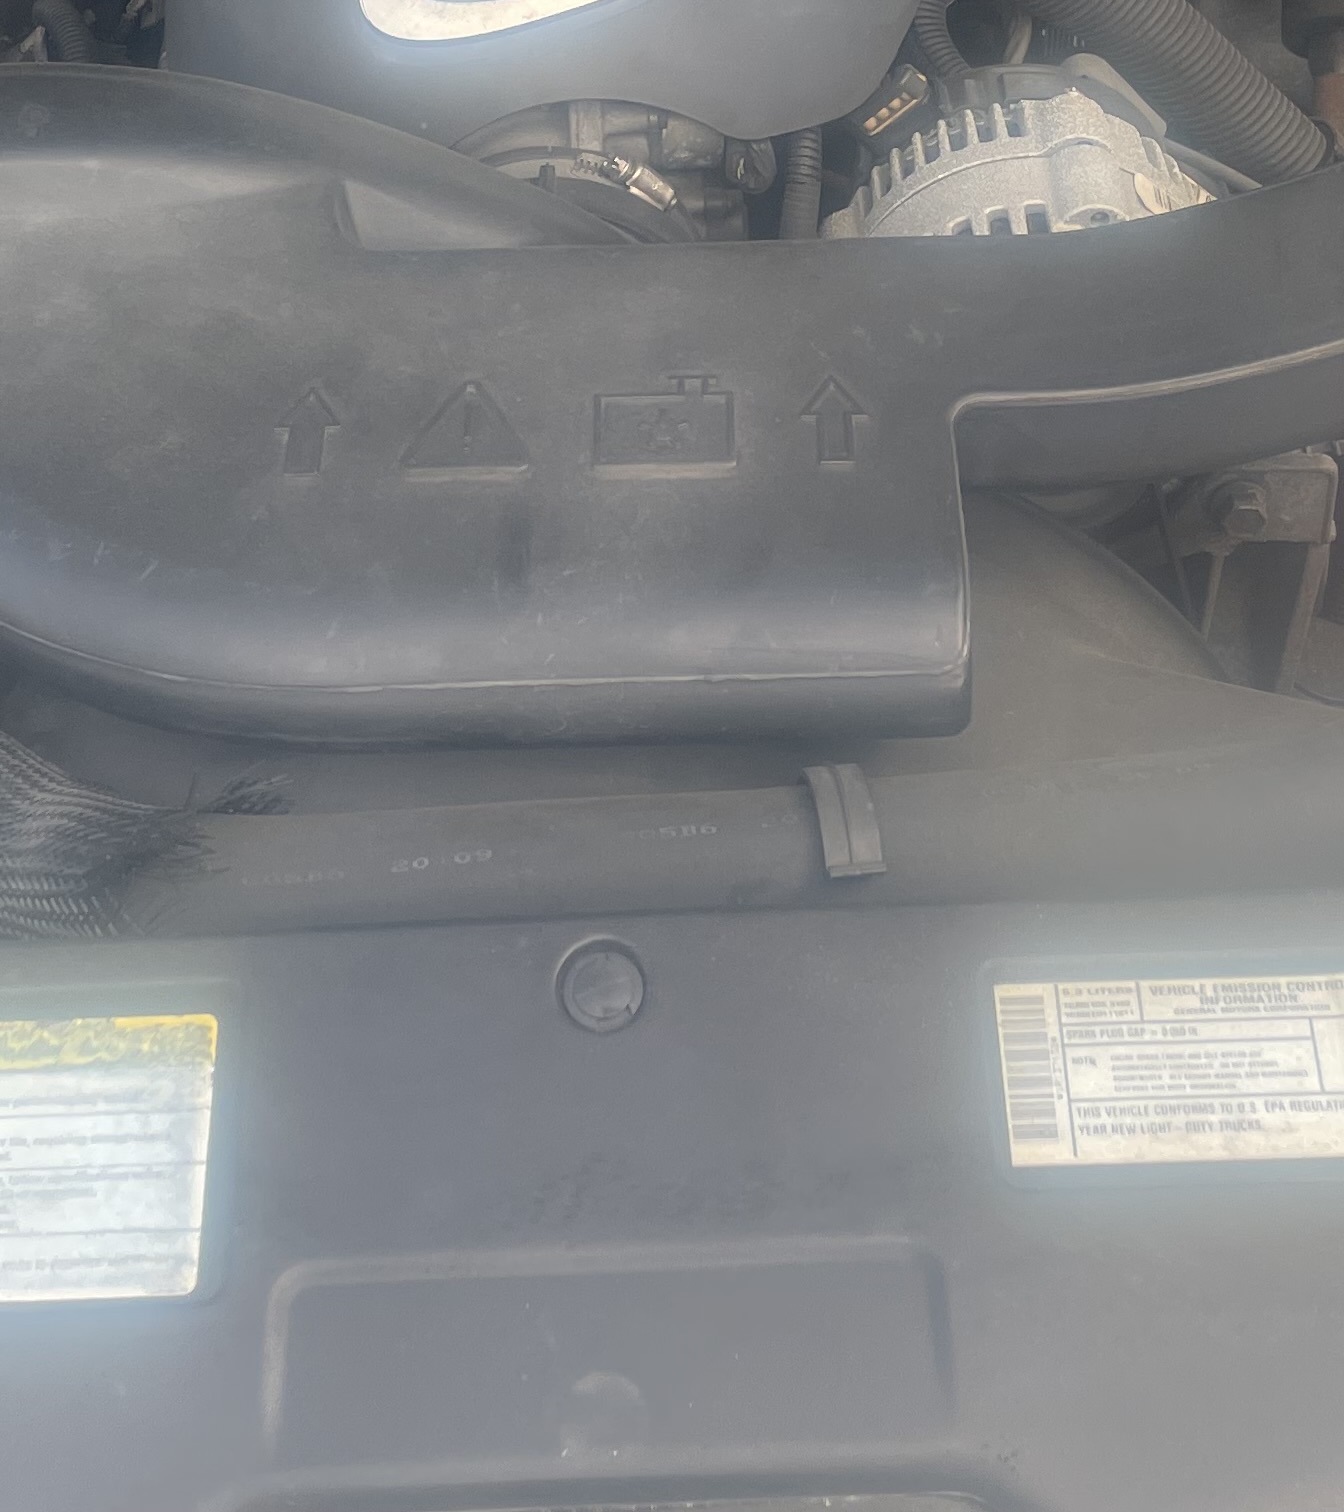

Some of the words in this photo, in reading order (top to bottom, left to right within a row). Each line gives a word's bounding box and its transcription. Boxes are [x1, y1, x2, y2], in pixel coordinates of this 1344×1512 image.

[1148, 984, 1207, 997] VEHICLE
[1212, 981, 1282, 995] EMISSION
[1199, 992, 1299, 1006] INFORMATION
[1077, 1105, 1102, 1119] THIS
[1105, 1103, 1150, 1118] VEHICLE
[1154, 1102, 1216, 1116] CONFORMS
[1220, 1102, 1234, 1115] TO
[1263, 1098, 1286, 1113] EPA
[1077, 1123, 1107, 1137] YEAR
[1111, 1122, 1137, 1135] NEW
[1140, 1120, 1172, 1134] LIGHT
[1219, 1118, 1263, 1133] TRUCKS
